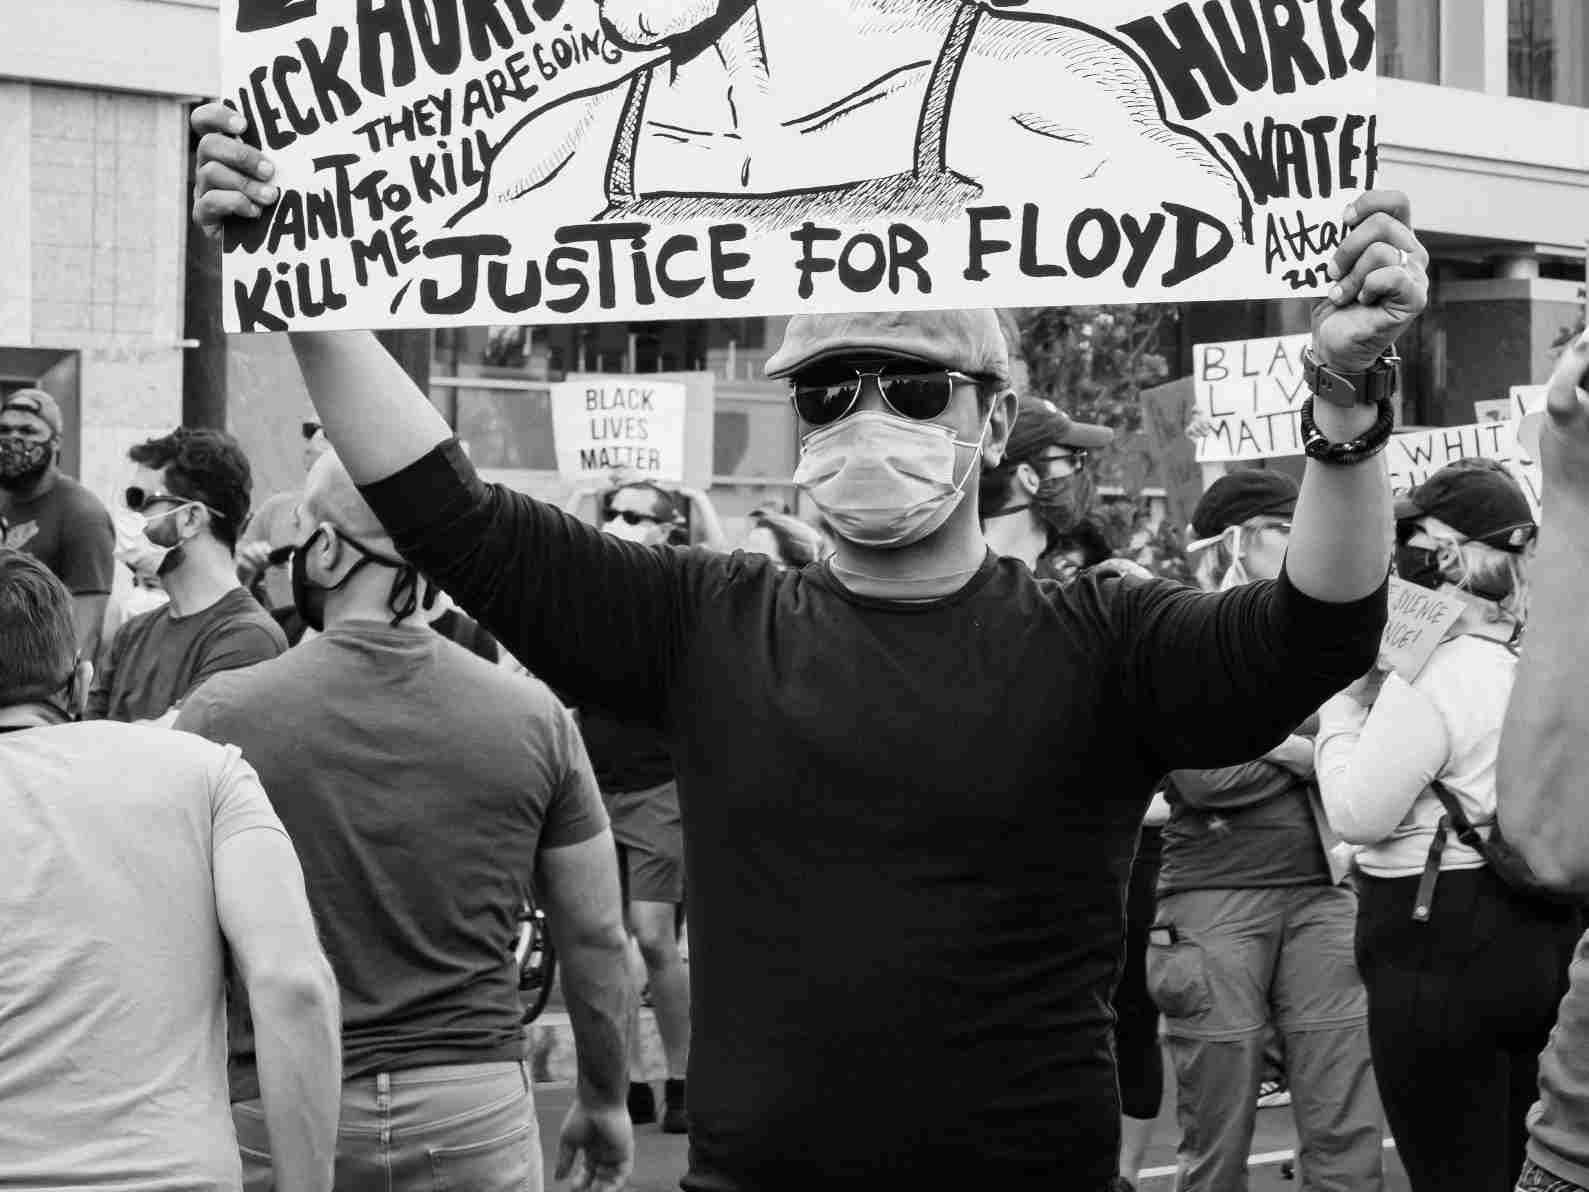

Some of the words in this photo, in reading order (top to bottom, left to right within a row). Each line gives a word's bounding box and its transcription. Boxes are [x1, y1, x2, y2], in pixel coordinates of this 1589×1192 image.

[353, 88, 452, 152] THEY
[462, 50, 539, 126] ARE
[350, 169, 412, 221] TO
[350, 214, 421, 287] ME
[790, 221, 932, 300] FOR
[963, 201, 1235, 289] FLOYD
[1265, 209, 1349, 275] Atta
[1202, 339, 1307, 382] BLA
[585, 387, 656, 412] BLACK
[1209, 376, 1305, 418] LIV
[591, 415, 649, 441] LIVES
[1202, 409, 1302, 457] MATT
[1398, 424, 1505, 466] WHIT
[579, 446, 661, 471] MATTER
